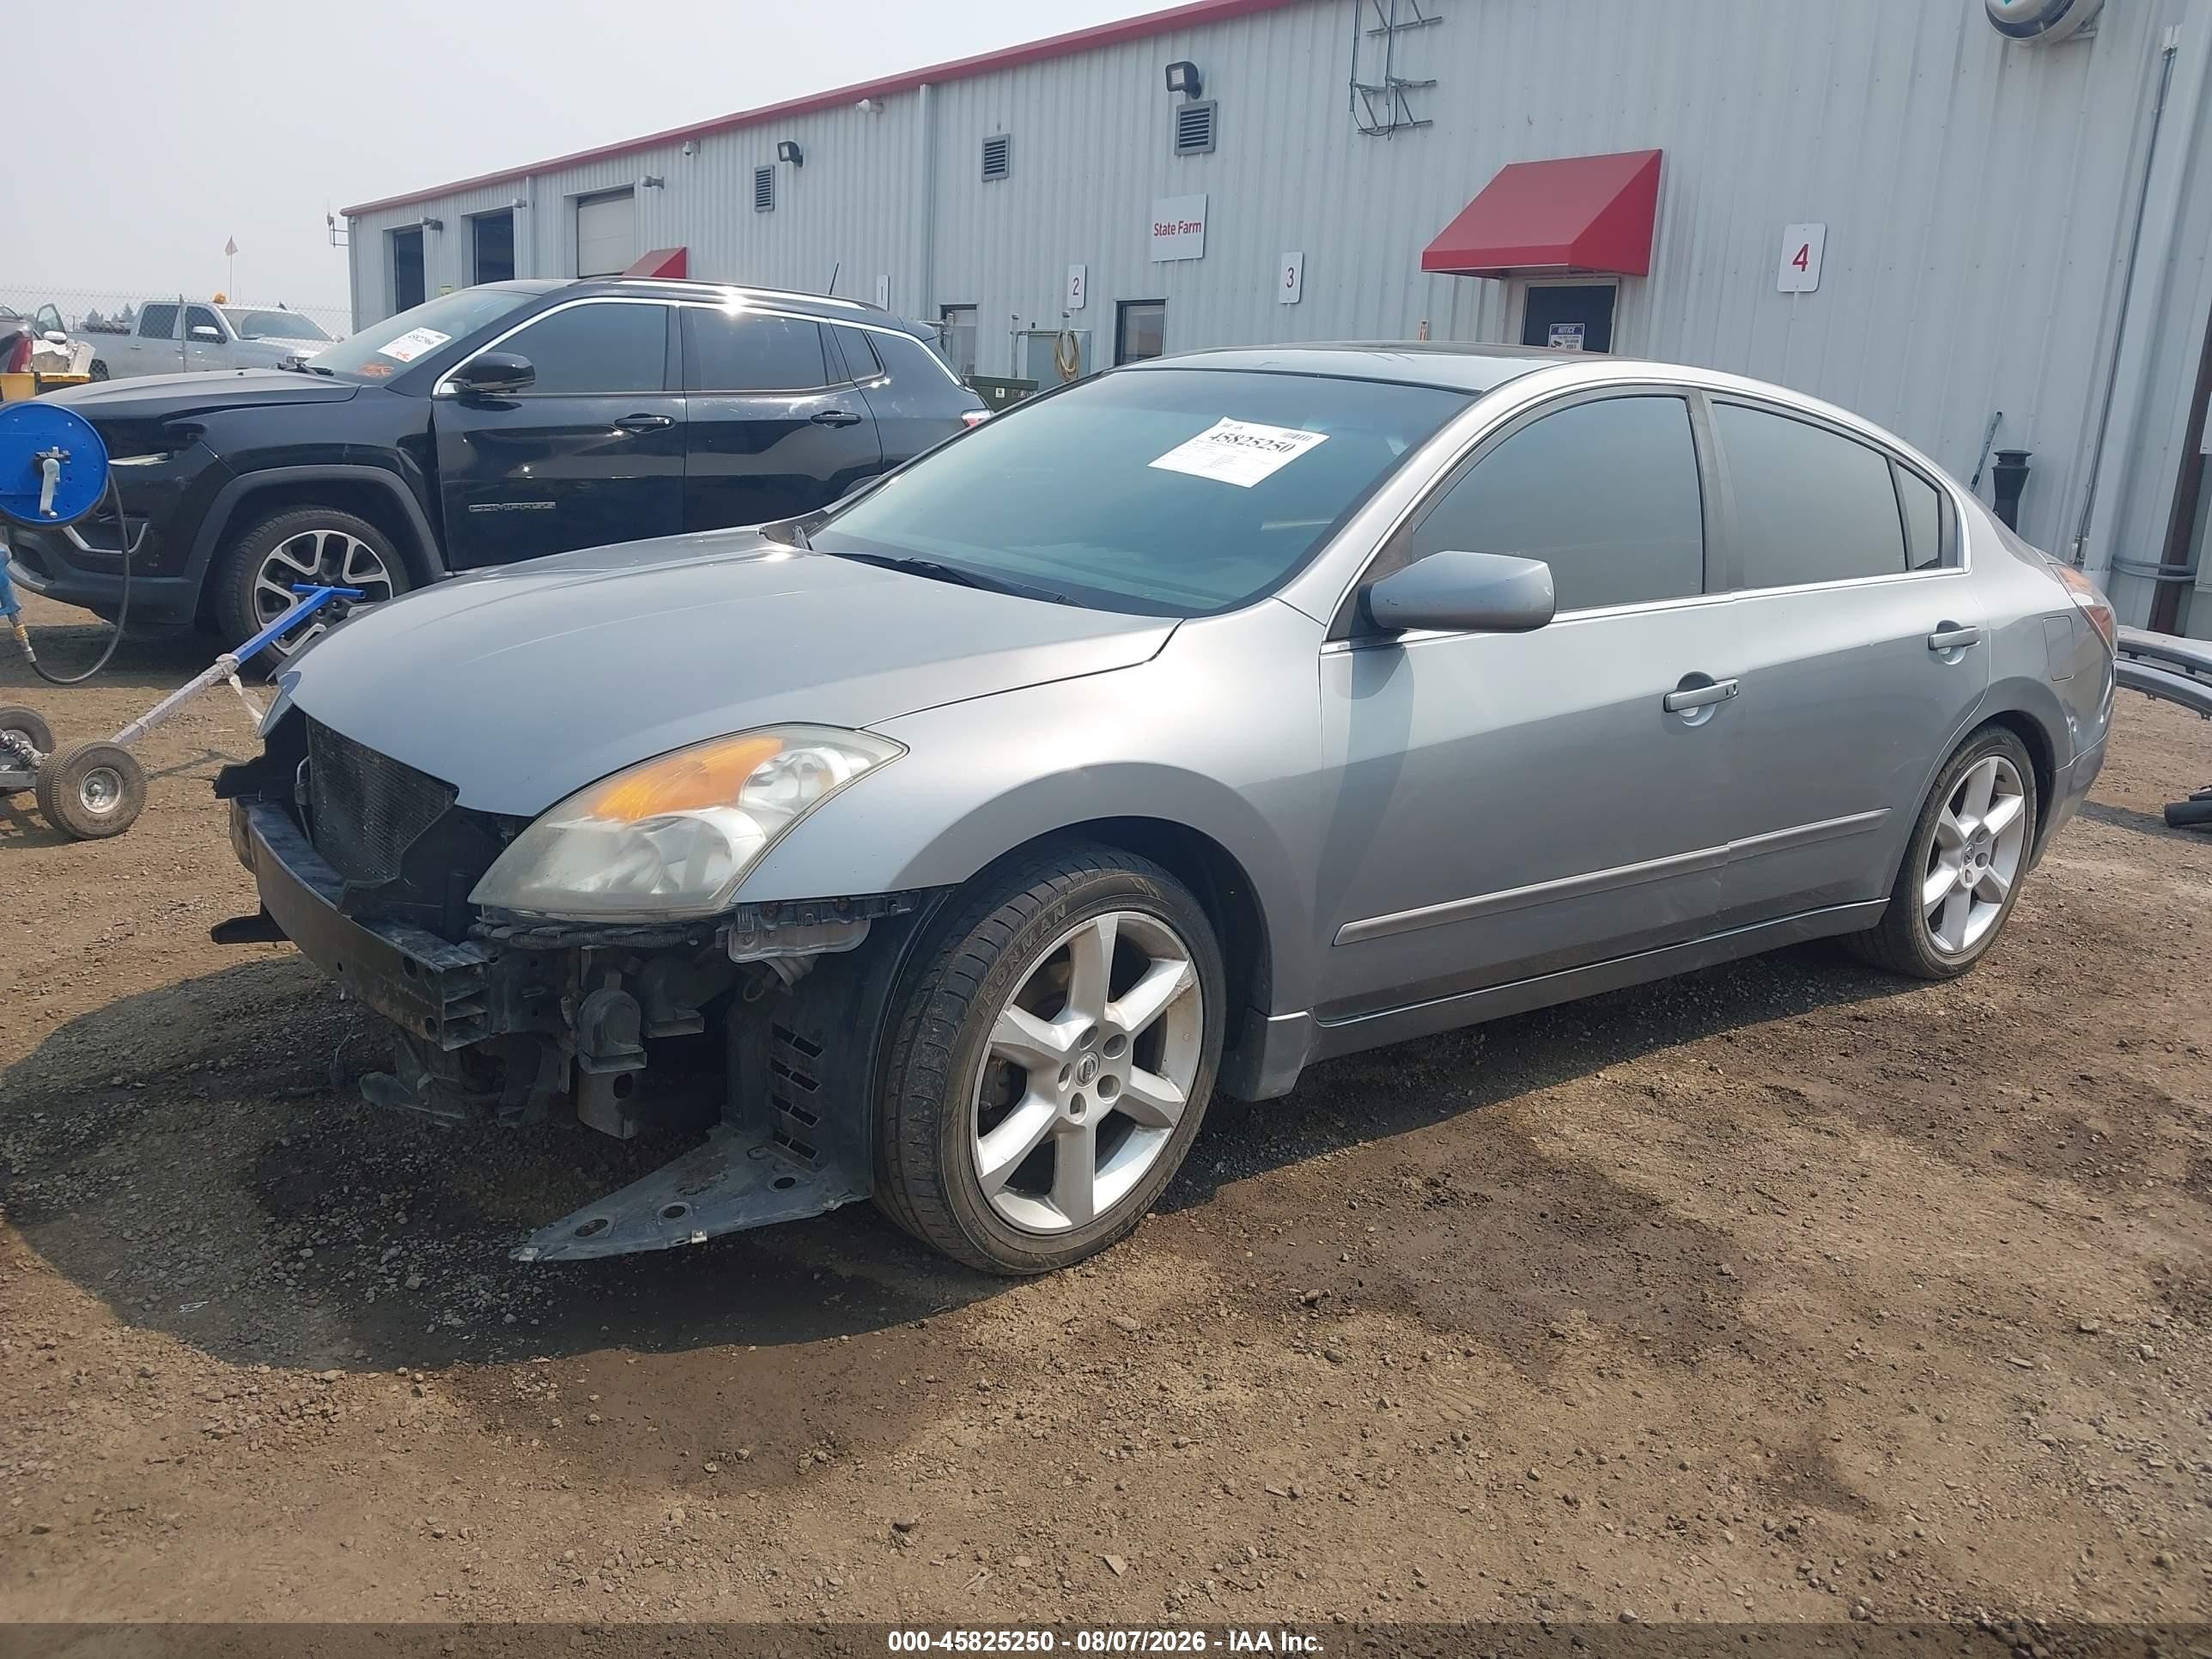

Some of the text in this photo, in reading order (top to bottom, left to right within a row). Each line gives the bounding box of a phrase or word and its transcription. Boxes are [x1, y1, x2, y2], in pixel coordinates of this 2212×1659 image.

[1153, 221, 1201, 237] State Farm
[1792, 243, 1809, 272] 4
[1072, 276, 1079, 296] 2
[1286, 267, 1294, 289] 3
[1209, 432, 1296, 453] 45825250
